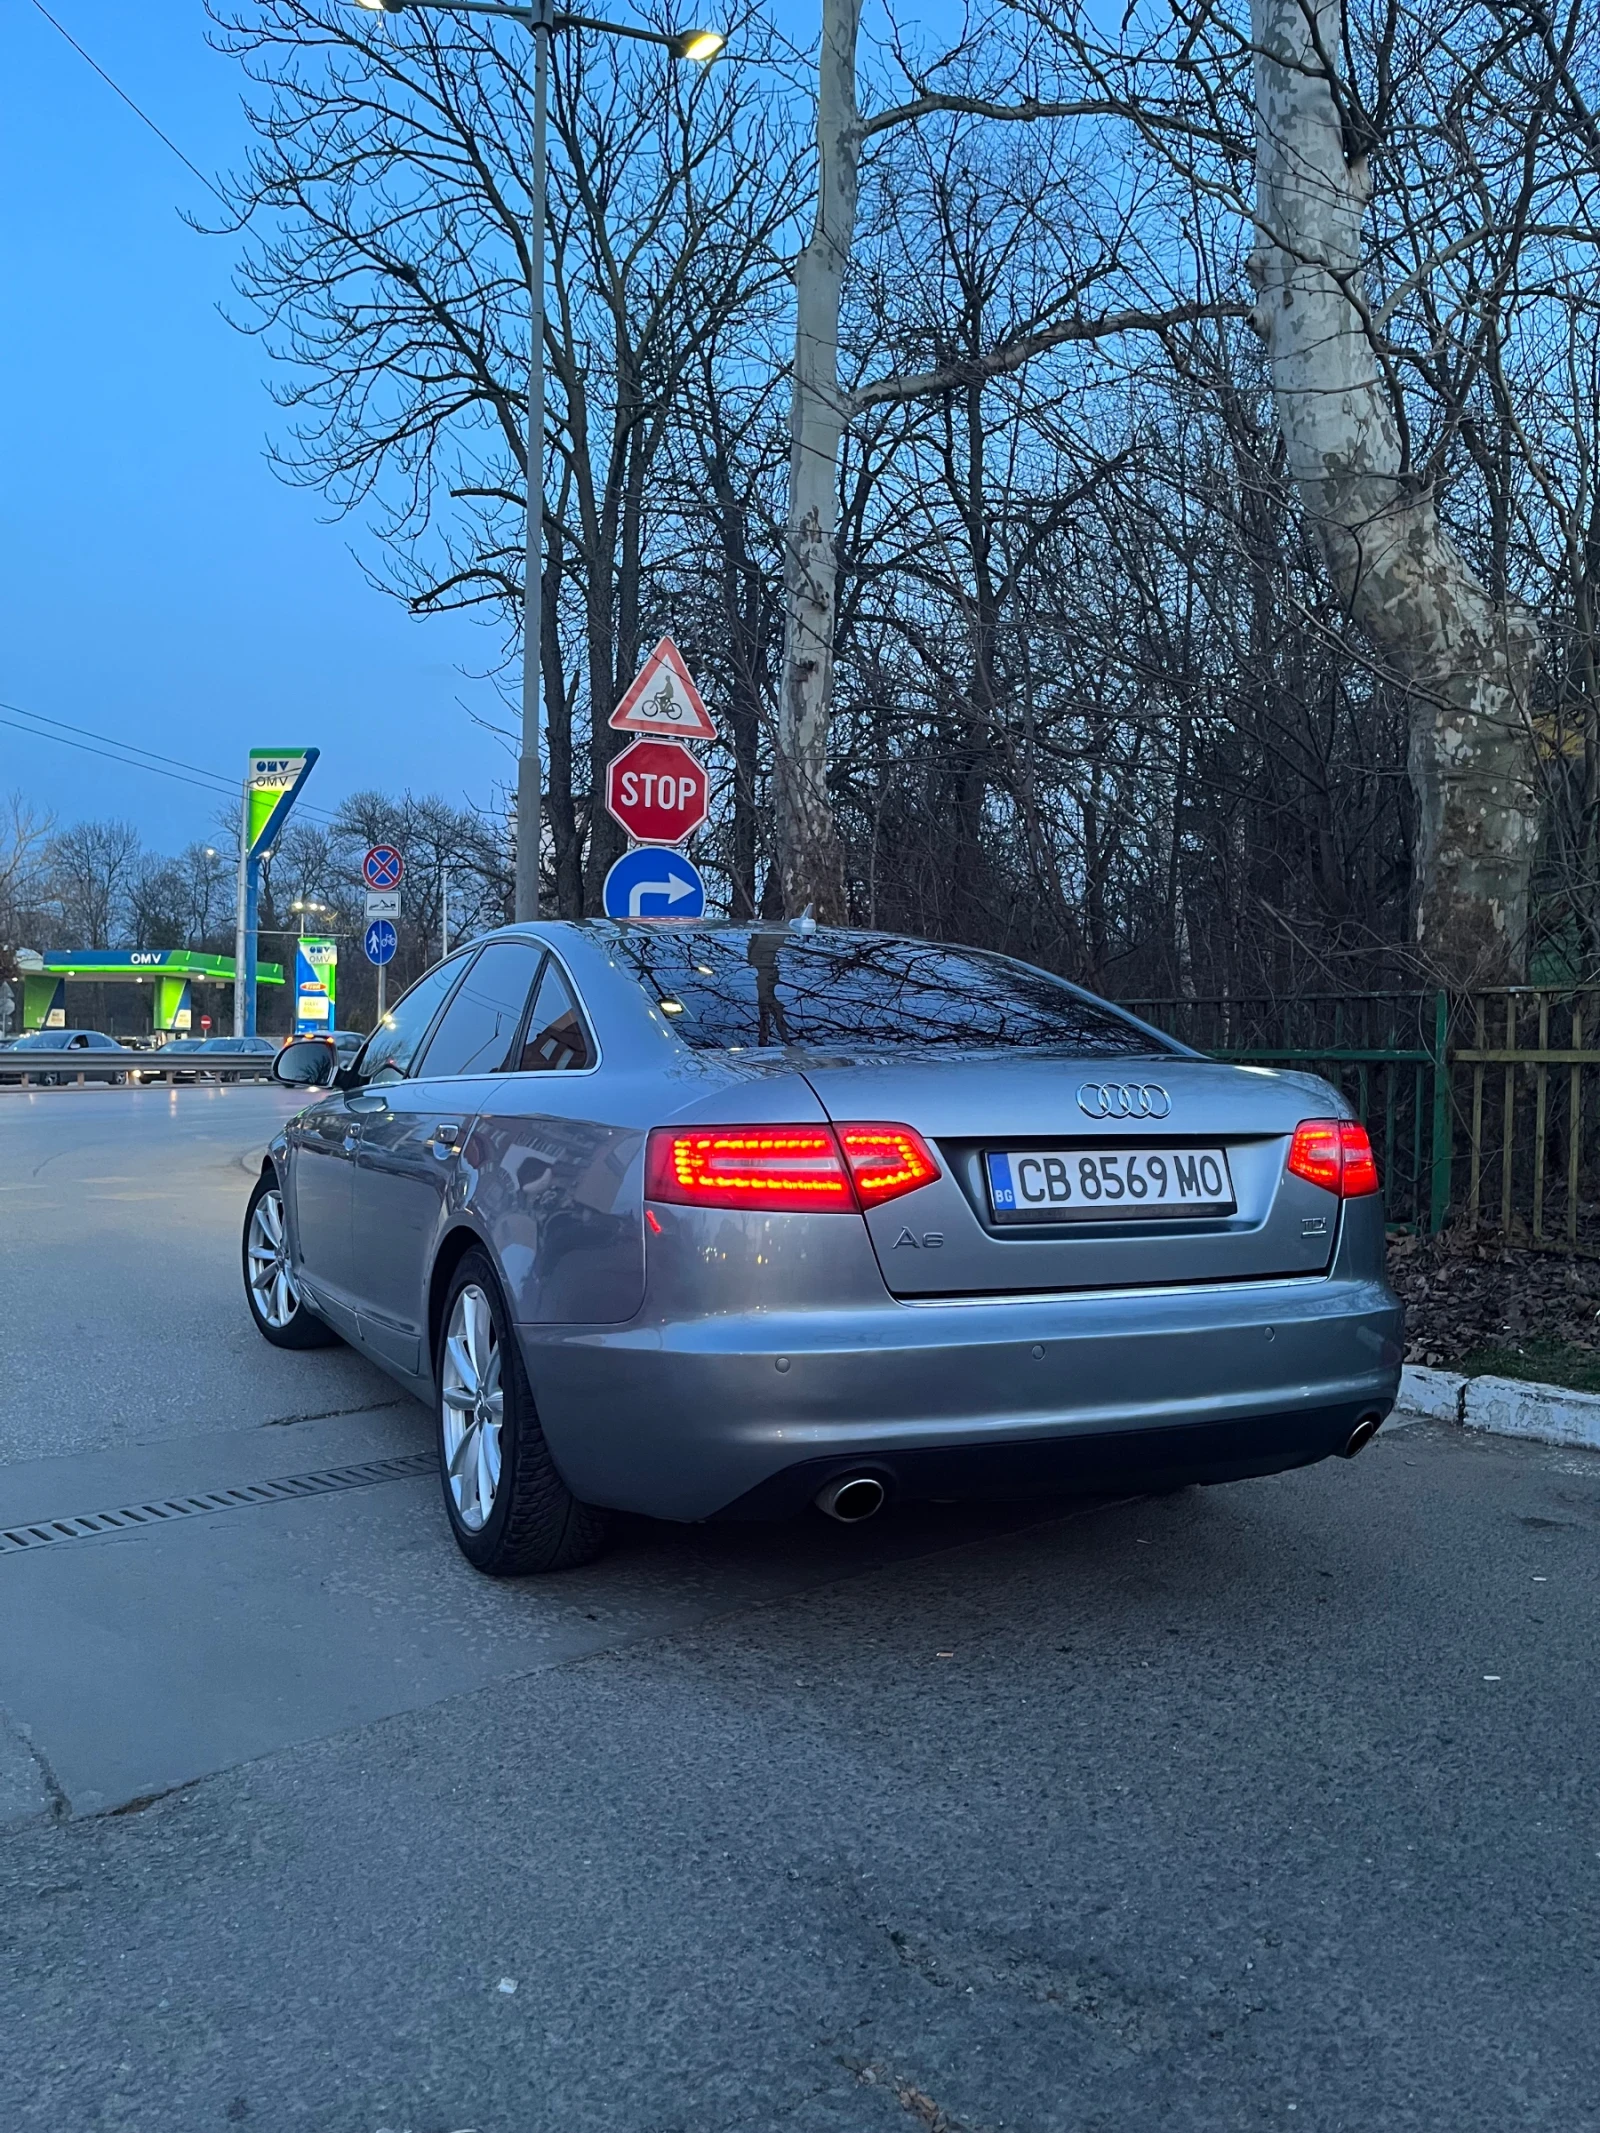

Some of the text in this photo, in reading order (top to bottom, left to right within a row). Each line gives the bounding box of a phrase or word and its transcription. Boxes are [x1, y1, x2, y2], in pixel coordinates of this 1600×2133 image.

[256, 776, 288, 787] OMV
[621, 771, 697, 811] STOP
[131, 953, 161, 964] OMV
[1018, 1155, 1223, 1202] CB 8569 MO
[995, 1189, 1013, 1203] BG
[892, 1226, 944, 1249] A6
